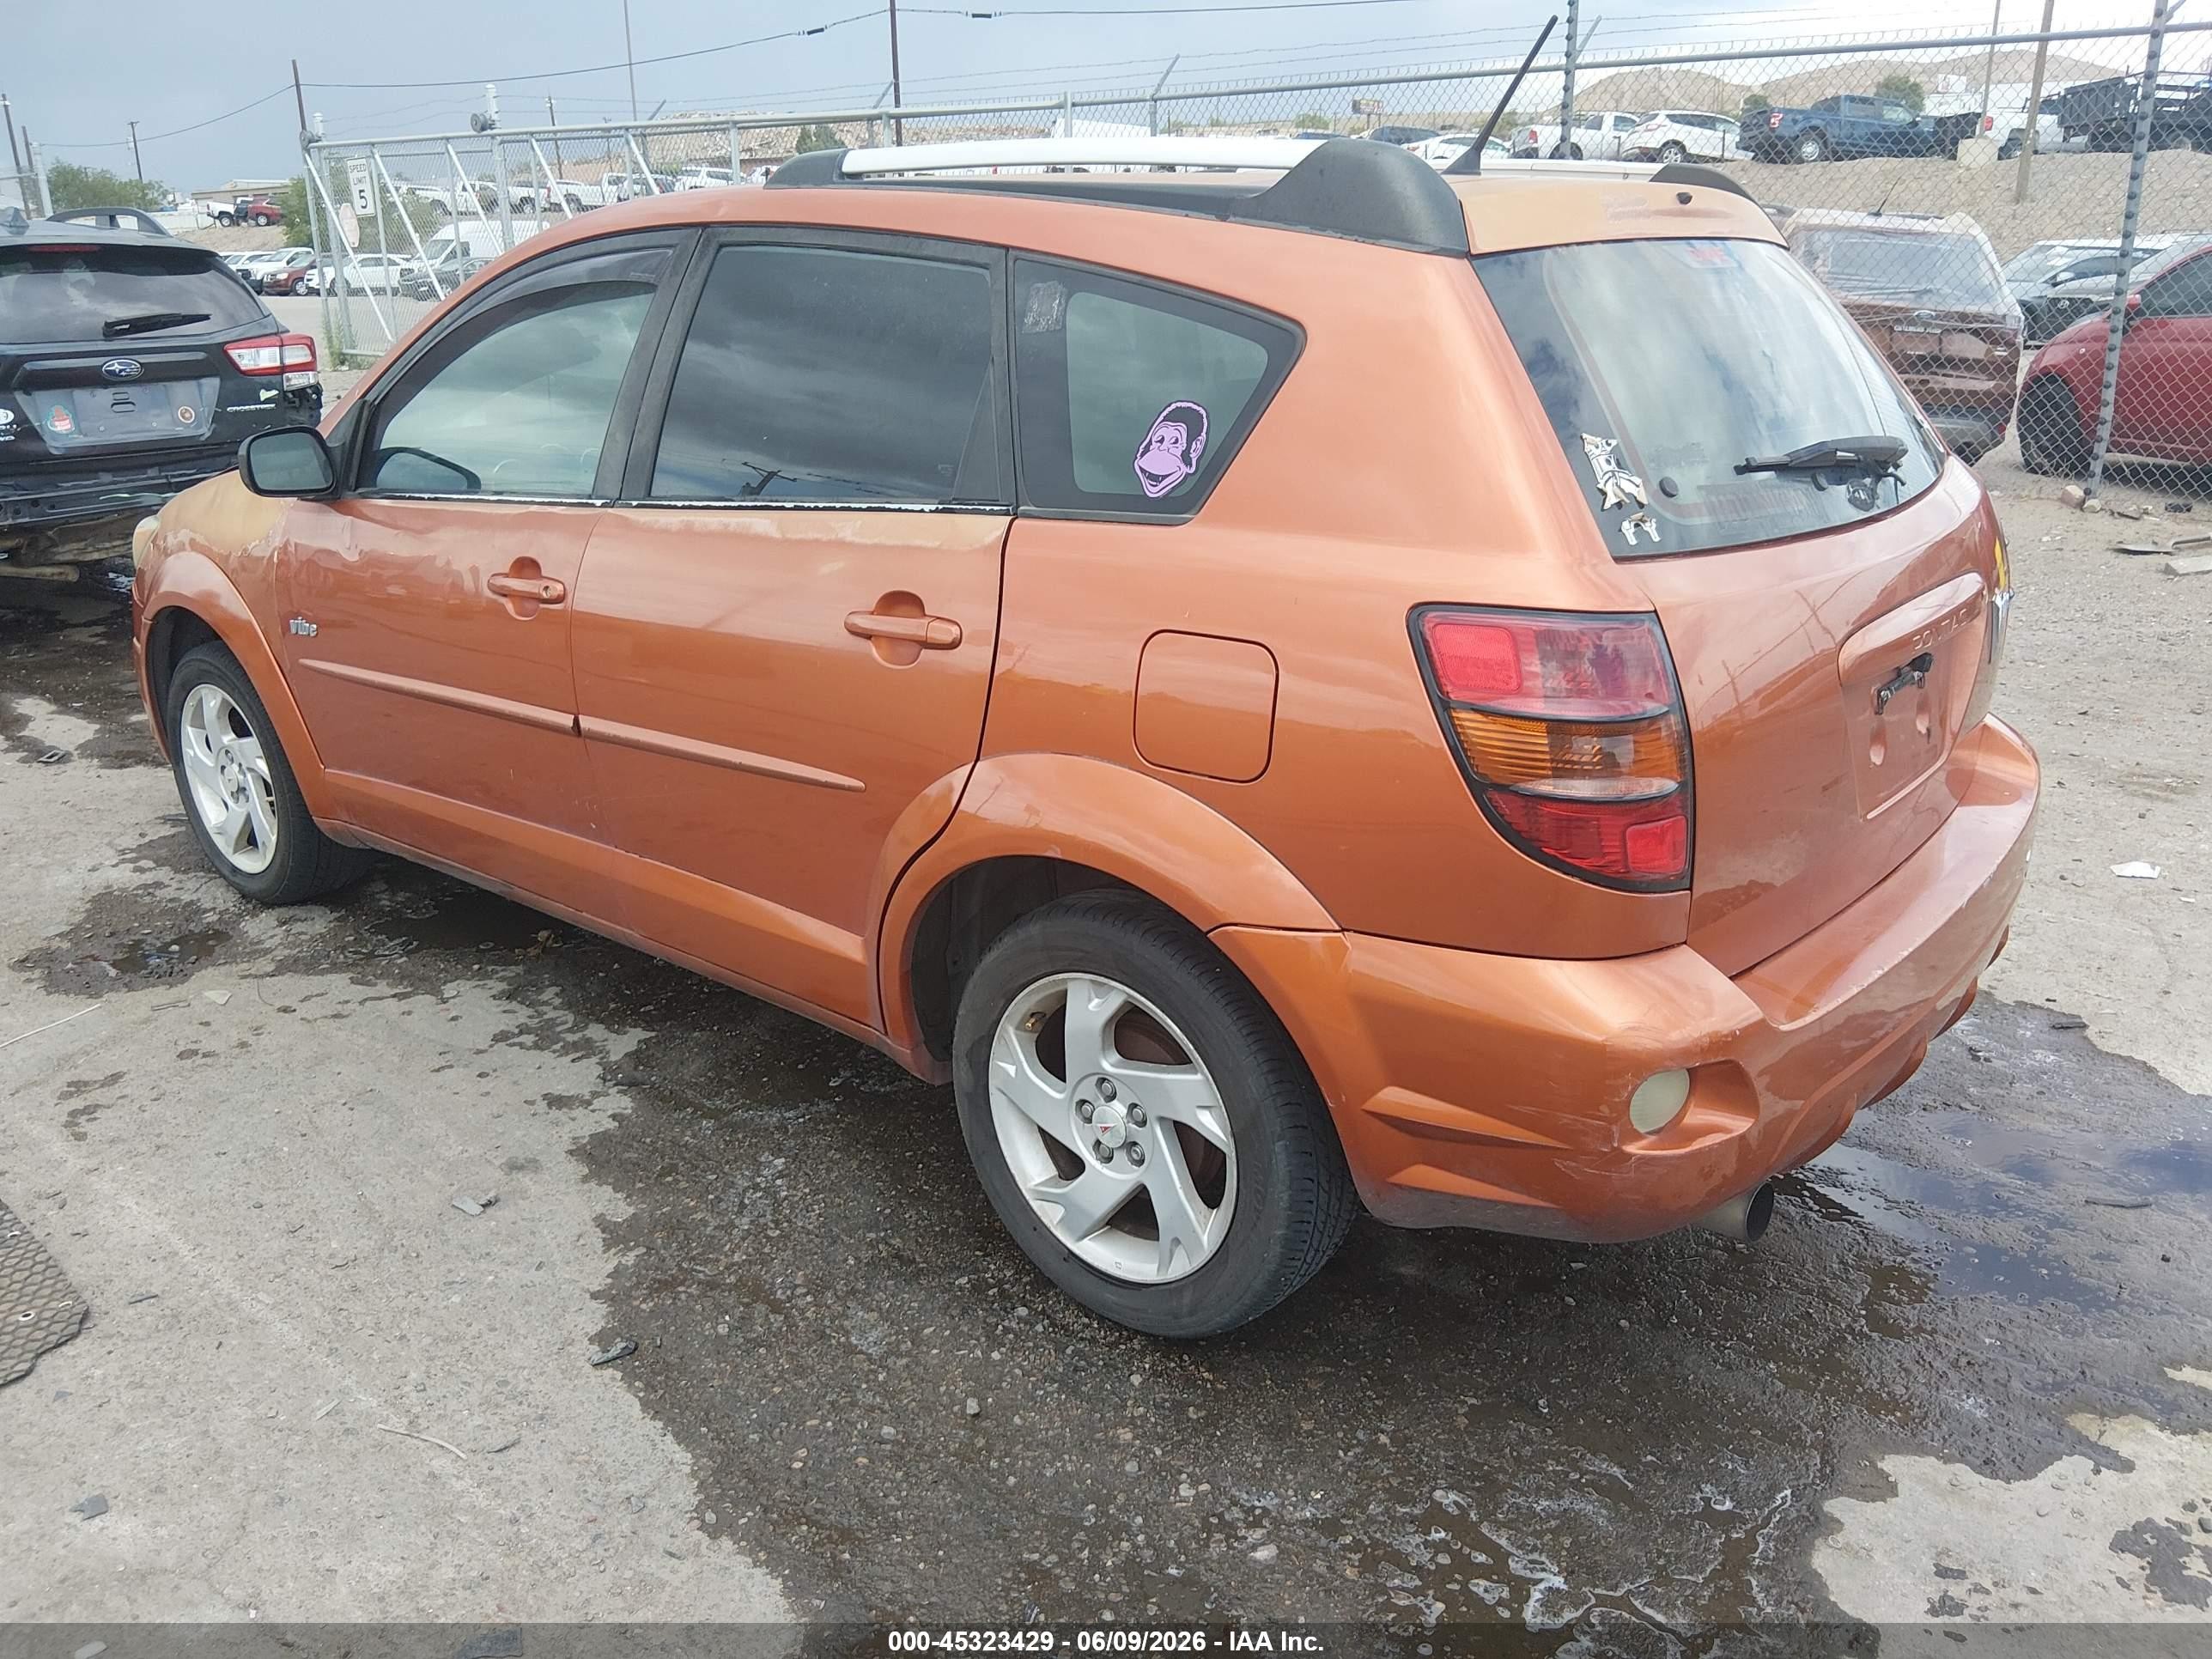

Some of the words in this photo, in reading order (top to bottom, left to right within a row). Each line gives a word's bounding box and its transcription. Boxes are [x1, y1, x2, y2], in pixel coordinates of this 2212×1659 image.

[349, 163, 368, 173] SPEED
[352, 175, 368, 186] LIMIT
[358, 189, 368, 210] 5
